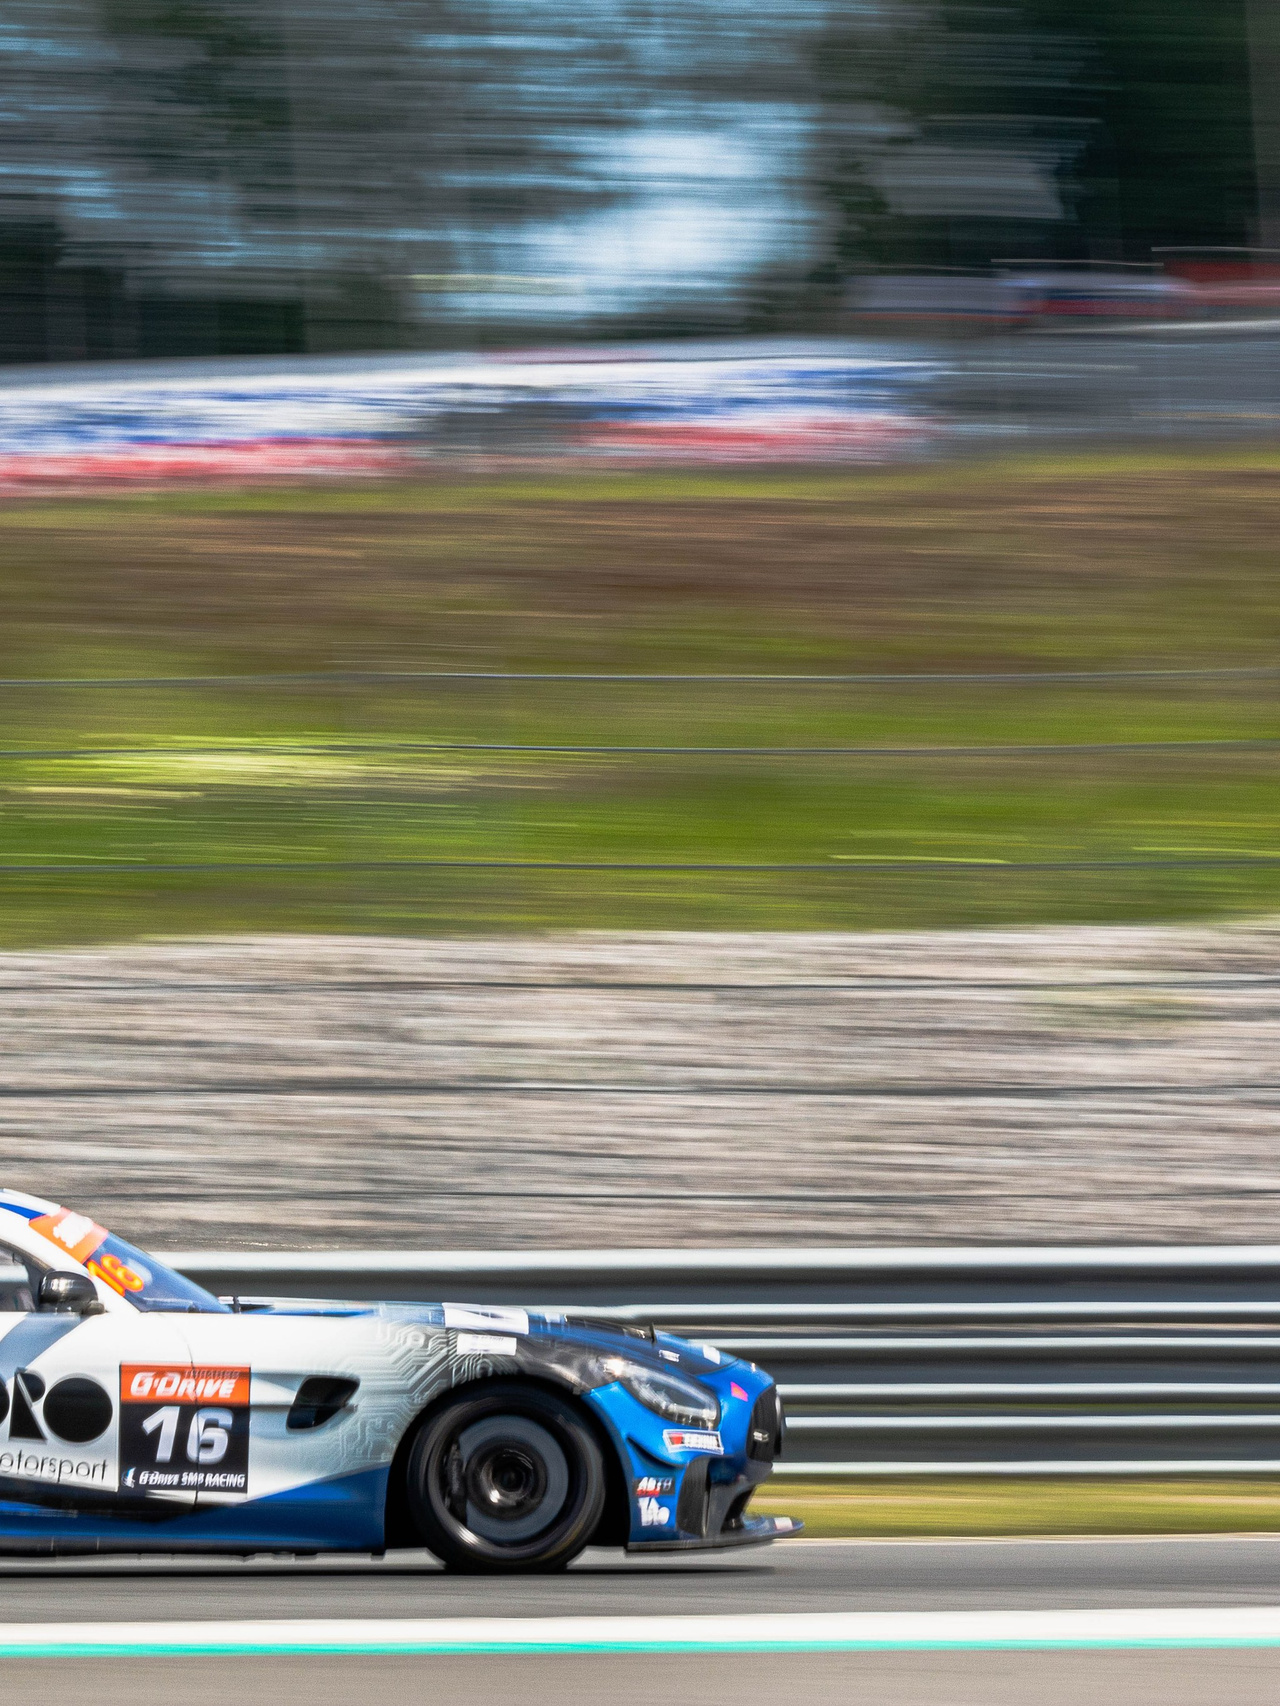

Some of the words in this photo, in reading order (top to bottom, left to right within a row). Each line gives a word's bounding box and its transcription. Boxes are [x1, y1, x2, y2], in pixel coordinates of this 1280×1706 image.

[86, 1253, 145, 1297] 16
[141, 1405, 235, 1465] 16
[204, 1473, 247, 1488] RACING
